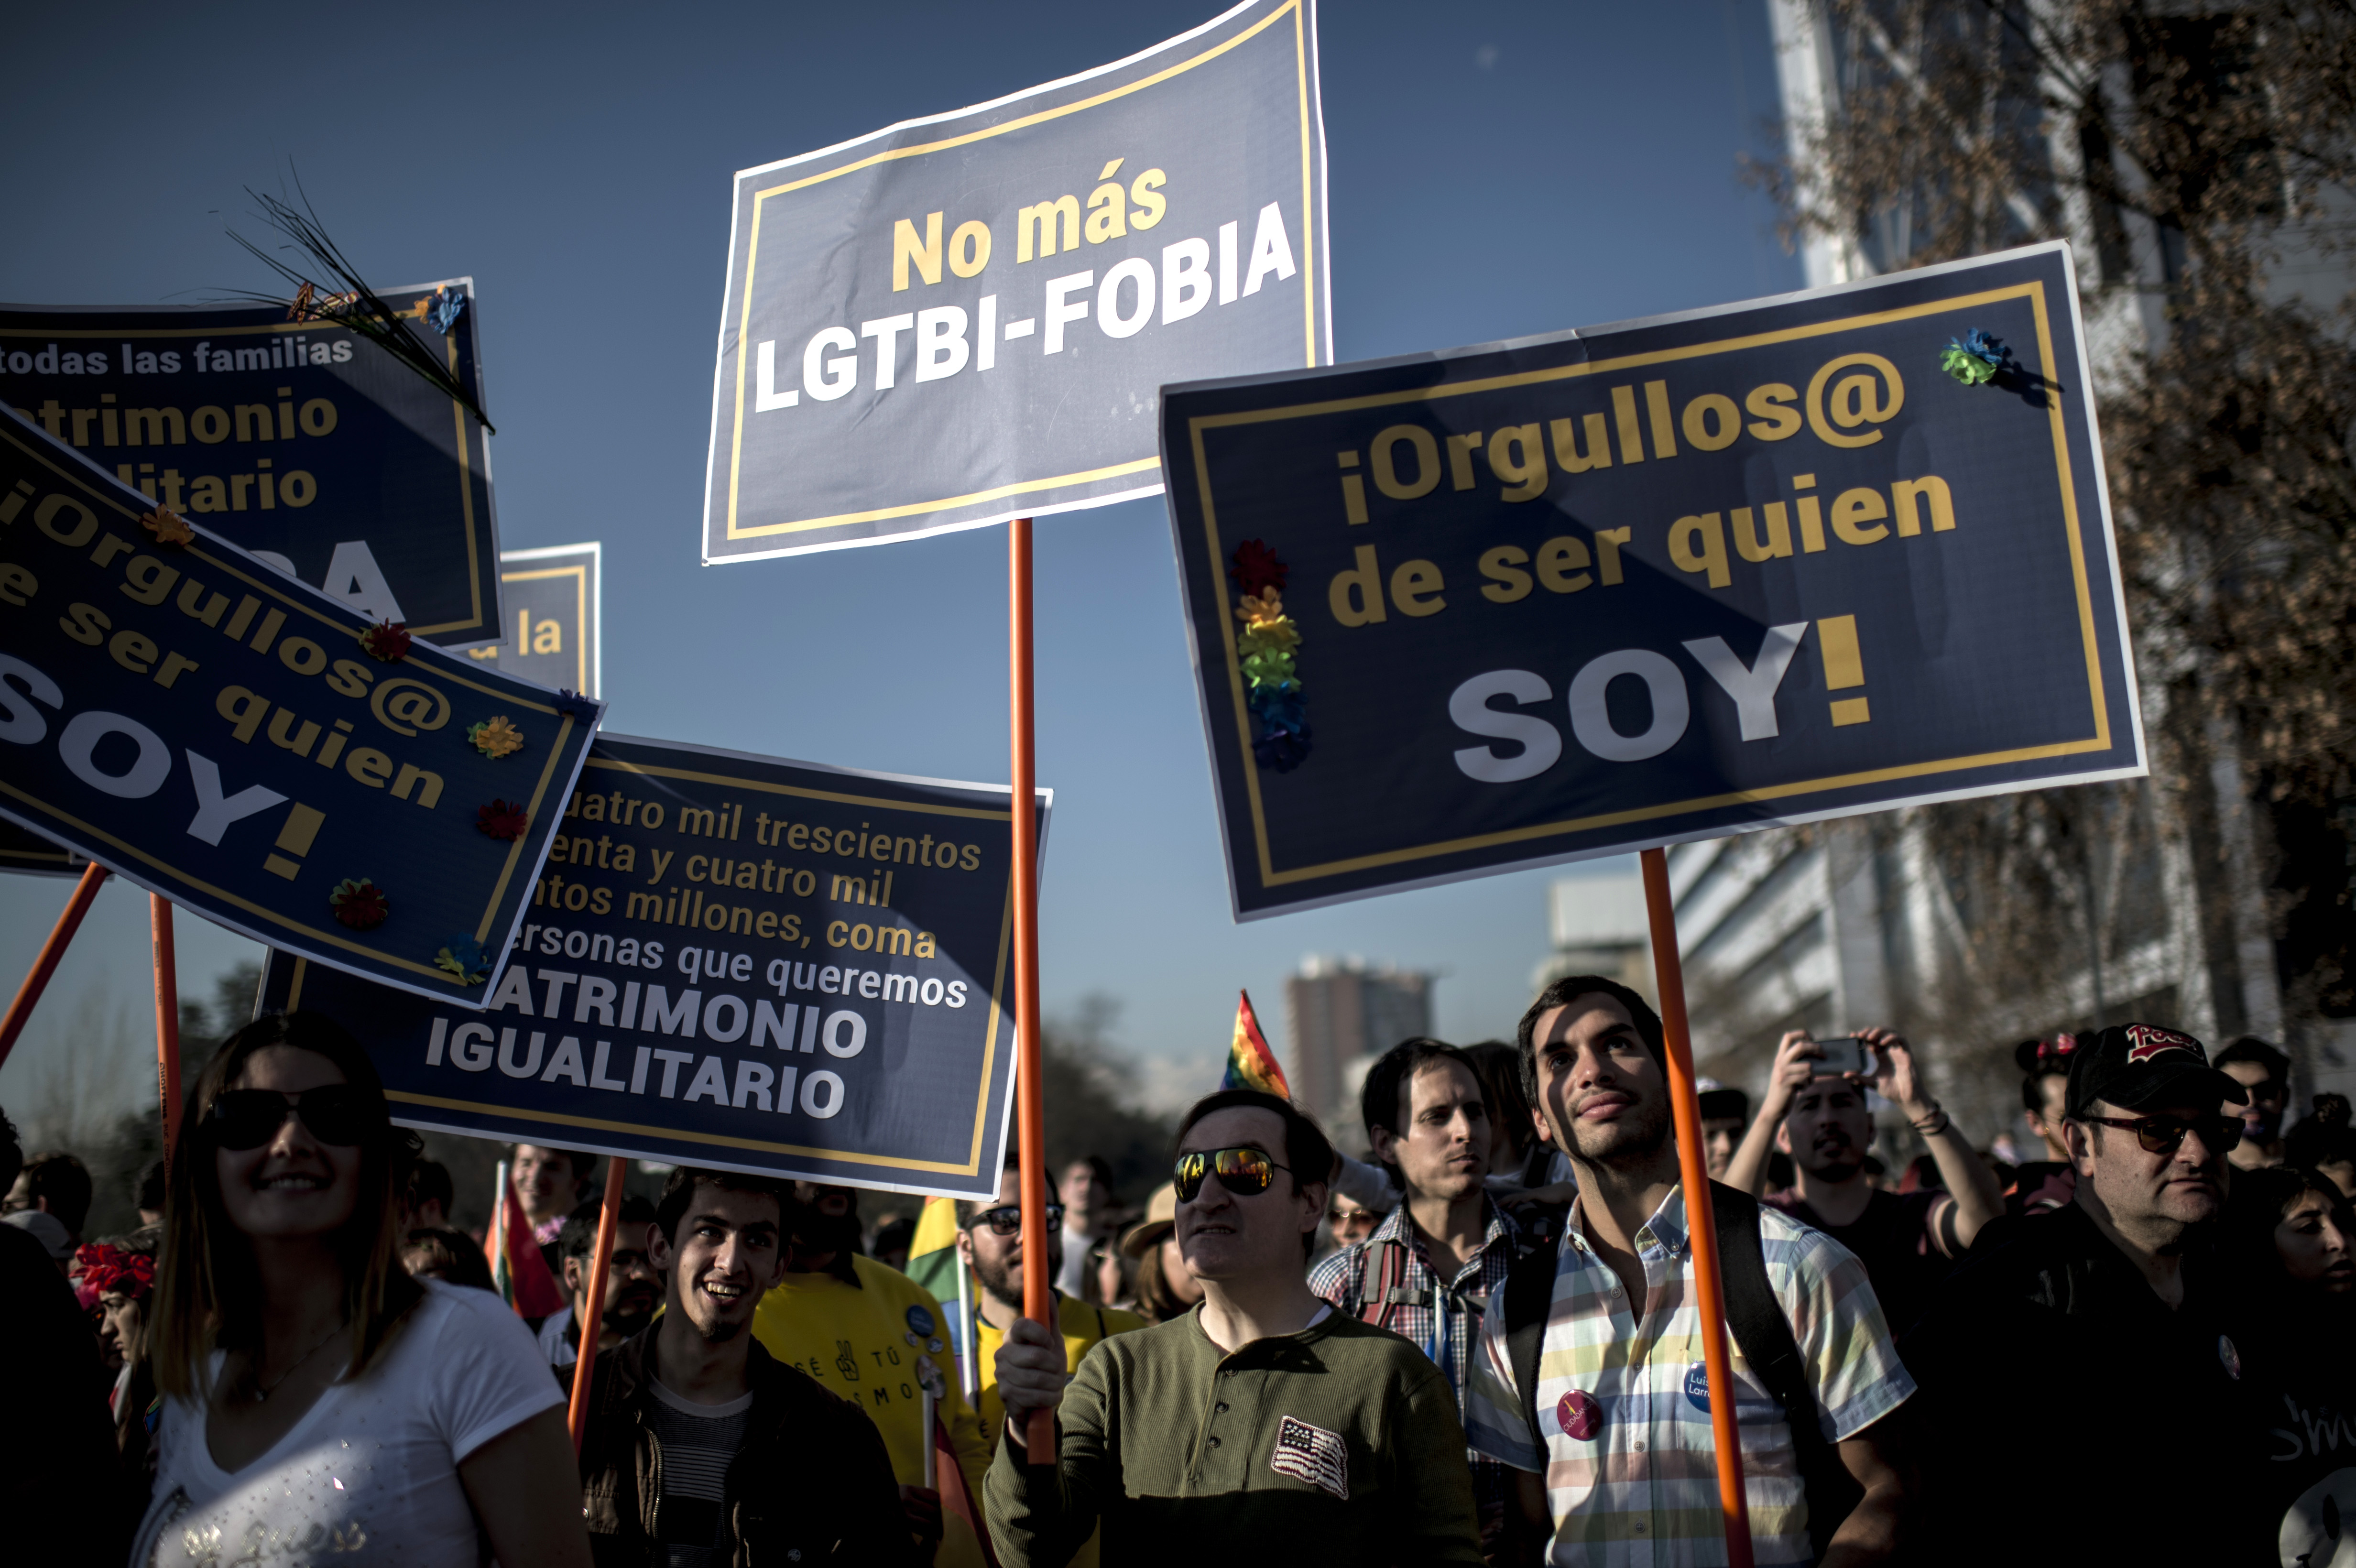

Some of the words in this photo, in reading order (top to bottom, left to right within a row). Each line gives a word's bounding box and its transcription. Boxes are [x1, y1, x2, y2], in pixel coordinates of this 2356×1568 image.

[893, 211, 992, 292] No
[1016, 157, 1167, 264] más
[755, 201, 1297, 414] LGTBI-FOBIA
[121, 343, 182, 375] las
[194, 336, 353, 372] familias
[13, 386, 338, 447] trimonio
[1337, 352, 1905, 526] ¡Orgullos@
[1328, 544, 1448, 628] de
[1480, 525, 1632, 605] ser
[1668, 472, 1956, 589] quien
[519, 609, 561, 656] la
[59, 601, 200, 689] ser
[215, 685, 445, 810] quien
[1449, 613, 1871, 784] SOY!
[0, 653, 327, 882] SOY!
[647, 850, 675, 884] y
[686, 852, 817, 898] cuatro
[830, 871, 894, 908] mil
[678, 803, 742, 842] mil
[756, 813, 982, 872] trescientos
[626, 888, 811, 948] millones,
[826, 920, 937, 959] coma
[486, 964, 868, 1059] ATRIMONIO
[678, 945, 753, 985] que
[766, 958, 968, 1008] queremos
[425, 1017, 845, 1120] IGUALITARIO
[871, 1346, 901, 1368] TÚ
[1563, 1400, 1595, 1432] CIUDADANOS
